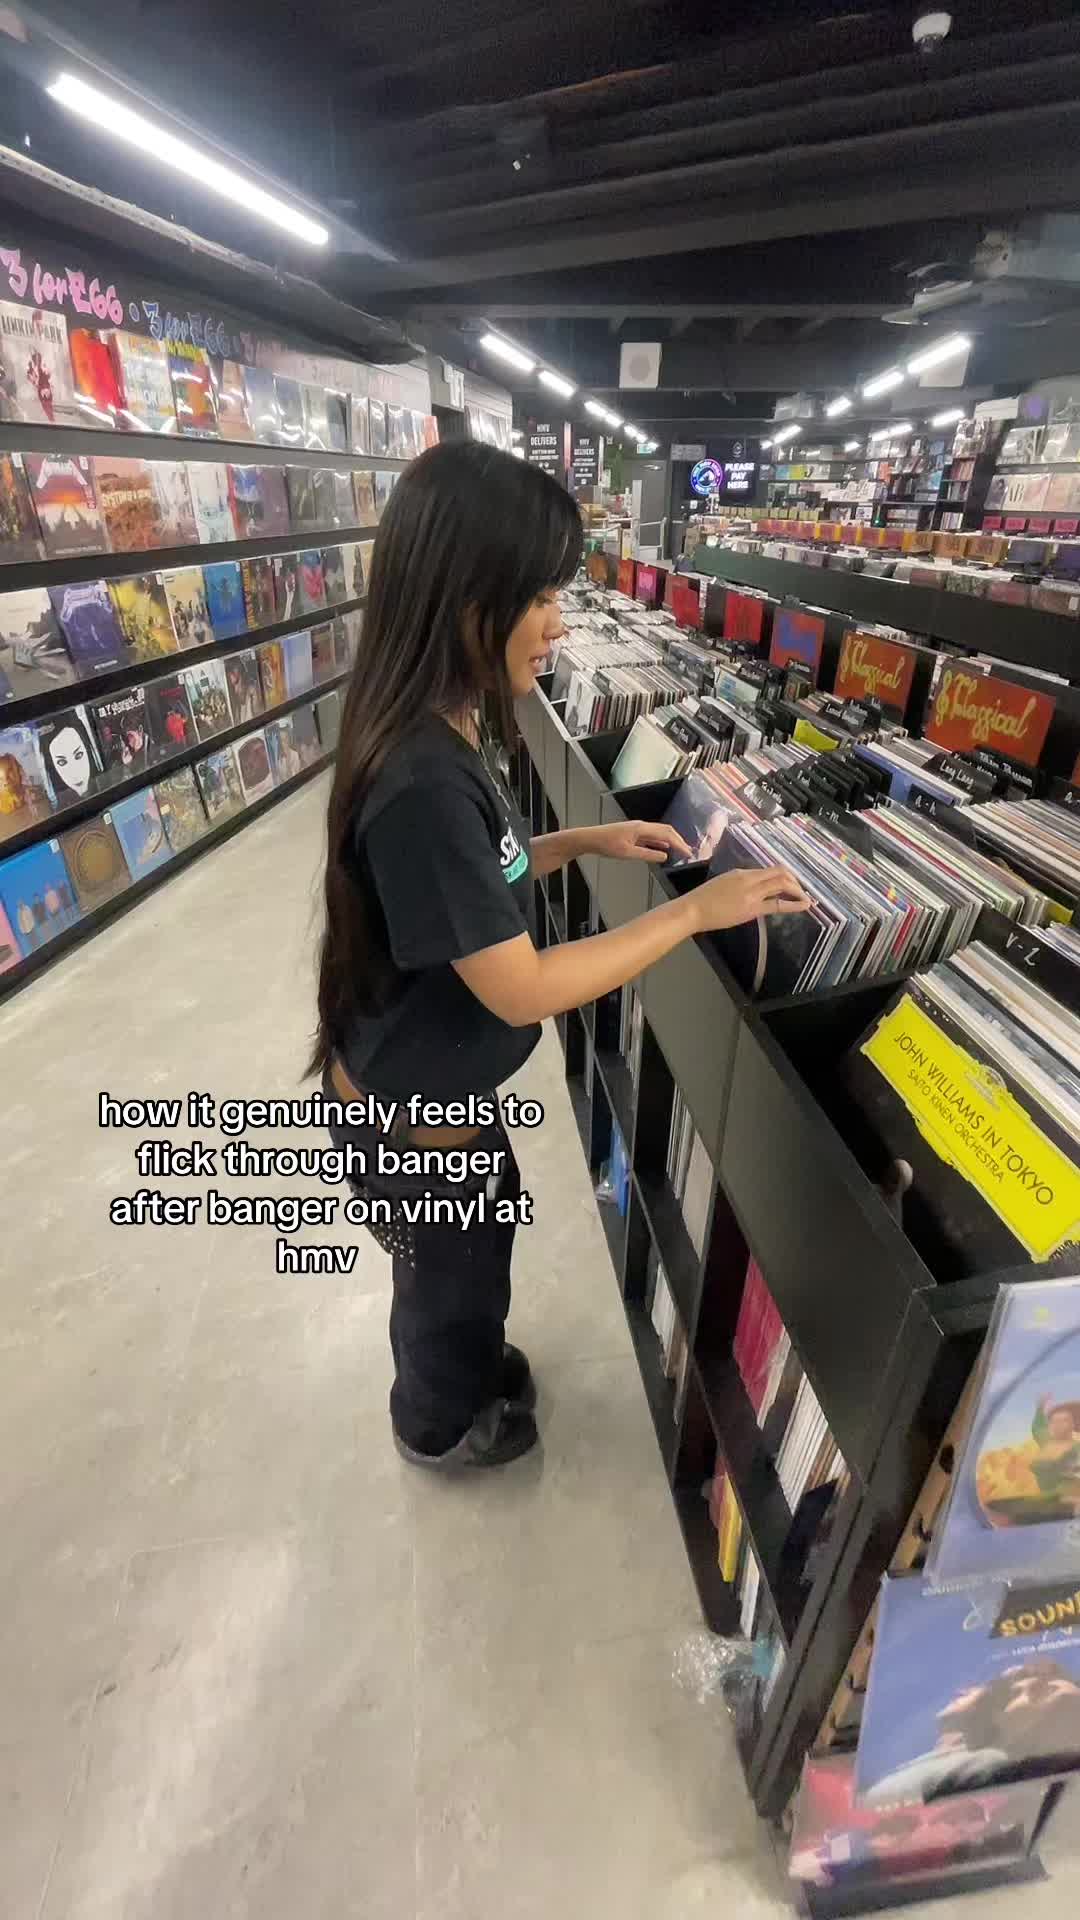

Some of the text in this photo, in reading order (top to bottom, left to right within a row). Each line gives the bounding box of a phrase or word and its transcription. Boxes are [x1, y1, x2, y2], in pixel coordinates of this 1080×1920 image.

[0, 247, 28, 297] 3
[142, 301, 162, 340] 3
[724, 462, 755, 472] PLEASE
[726, 480, 749, 489] HERE
[730, 471, 747, 481] PAY
[852, 638, 905, 695] Classical
[952, 672, 1038, 741] Classical
[894, 1032, 929, 1067] JOHN
[927, 1062, 985, 1130] WILLIAMS
[984, 1126, 1002, 1148] IN
[1000, 1144, 1054, 1206] TOKYO
[907, 1069, 931, 1096] SAITO
[930, 1093, 954, 1125] KINEN
[954, 1122, 1005, 1184] ORCHESTRA
